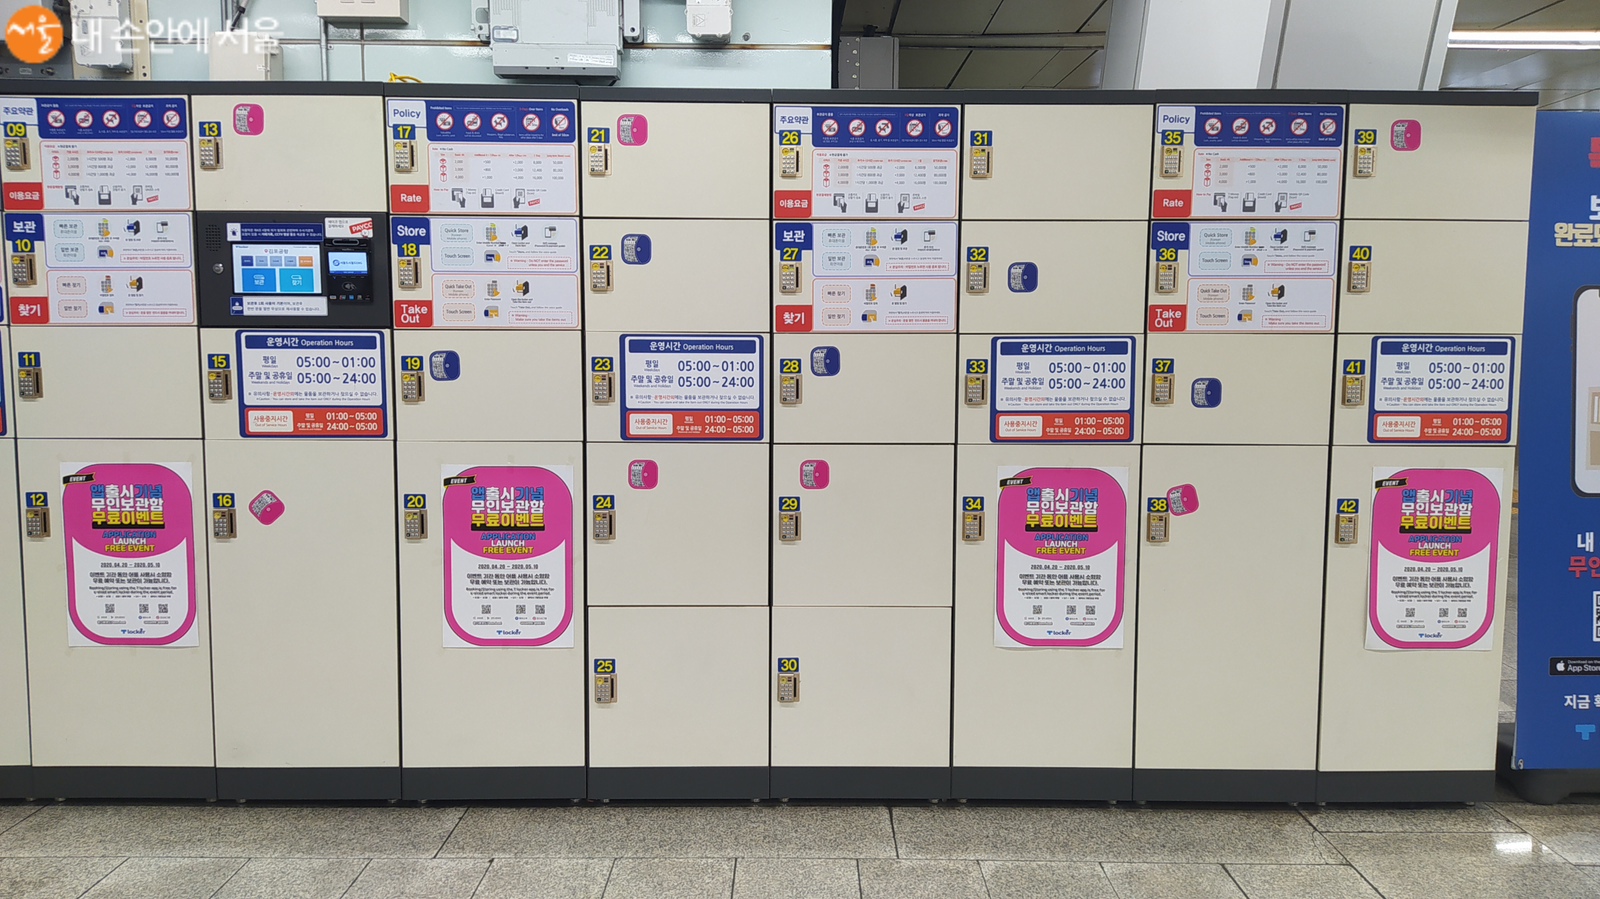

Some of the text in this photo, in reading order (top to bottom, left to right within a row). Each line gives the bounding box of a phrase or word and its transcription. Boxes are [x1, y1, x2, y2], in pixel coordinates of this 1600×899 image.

[3, 107, 34, 116] 주요약관
[393, 109, 421, 119] Policy
[780, 116, 809, 124] 주요약관
[1163, 115, 1190, 125] Policy
[6, 122, 26, 137] 09
[203, 122, 219, 137] 13
[397, 125, 412, 139] 17
[590, 128, 605, 142] 21
[782, 131, 799, 145] 26
[973, 131, 988, 145] 31
[1164, 131, 1182, 145] 35
[1357, 130, 1375, 144] 39
[9, 192, 40, 200] 이용요금
[400, 193, 422, 202] Rate
[1163, 198, 1184, 207] Rate
[779, 199, 808, 208] 이용요금
[13, 221, 36, 233] 보관
[397, 225, 426, 236] Store
[782, 230, 805, 243] 보관
[1157, 230, 1185, 241] Store
[15, 238, 32, 252] 10
[401, 242, 417, 257] 18
[592, 246, 609, 260] 22
[782, 247, 799, 261] 27
[969, 247, 987, 261] 32
[1158, 247, 1177, 261] 36
[1351, 247, 1369, 261] 40
[18, 304, 41, 316] 찾기
[401, 304, 428, 314] Take
[1156, 309, 1182, 318] Take
[401, 314, 420, 323] Out
[783, 312, 805, 324] 찾기
[1155, 318, 1173, 327] Out
[266, 337, 299, 346] 운영시간
[301, 339, 333, 347] Operation
[650, 342, 681, 351] 운영시간
[683, 343, 714, 351] Operation
[1021, 344, 1052, 353] 운영시간
[1054, 345, 1085, 353] Operation
[1402, 344, 1433, 353] 운영시간
[1435, 345, 1465, 353] Operation
[23, 353, 35, 367] 11
[211, 355, 227, 368] 15
[263, 355, 277, 364] 평일
[405, 356, 421, 370] 19
[594, 357, 611, 371] 23
[645, 359, 659, 368] 평일
[782, 359, 800, 372] 28
[1016, 362, 1030, 370] 평일
[1155, 359, 1172, 373] 37
[1396, 362, 1410, 370] 평일
[969, 360, 986, 373] 33
[1345, 361, 1361, 374] 41
[248, 372, 262, 380] 주말
[264, 372, 270, 380] 및
[273, 371, 293, 380] 공휴일
[631, 376, 645, 384] 주말
[646, 376, 653, 384] 및
[654, 375, 674, 383] 공휴일
[1001, 377, 1015, 386] 주말
[1017, 378, 1023, 386] 및
[1025, 377, 1044, 386] 공휴일
[1381, 377, 1395, 386] 주말
[1396, 378, 1403, 386] 및
[1404, 377, 1424, 386] 공휴일
[254, 415, 288, 423] 사용중지시간
[634, 418, 668, 426] 사용중지시간
[1004, 420, 1038, 428] 사용중지시간
[1382, 420, 1416, 428] 사용중지시간
[30, 493, 45, 506] 12
[91, 498, 164, 511] 무인보관함
[217, 494, 233, 507] 16
[407, 495, 424, 508] 20
[595, 496, 612, 509] 24
[781, 497, 798, 510] 29
[965, 497, 982, 511] 34
[1150, 498, 1167, 511] 38
[471, 500, 544, 514] 무인보관함
[1026, 501, 1098, 515] 무인보관함
[1339, 500, 1357, 513] 42
[1401, 503, 1473, 516] 무인보관함
[92, 511, 164, 525] 무료이벤트
[471, 513, 544, 527] 무료이벤트
[1026, 514, 1097, 528] 무료이벤트
[1400, 516, 1471, 530] 무료이벤트
[1577, 532, 1594, 552] 내
[596, 659, 613, 672] 25
[780, 658, 798, 671] 30
[1567, 665, 1582, 673] App
[1564, 694, 1590, 709] 지금
